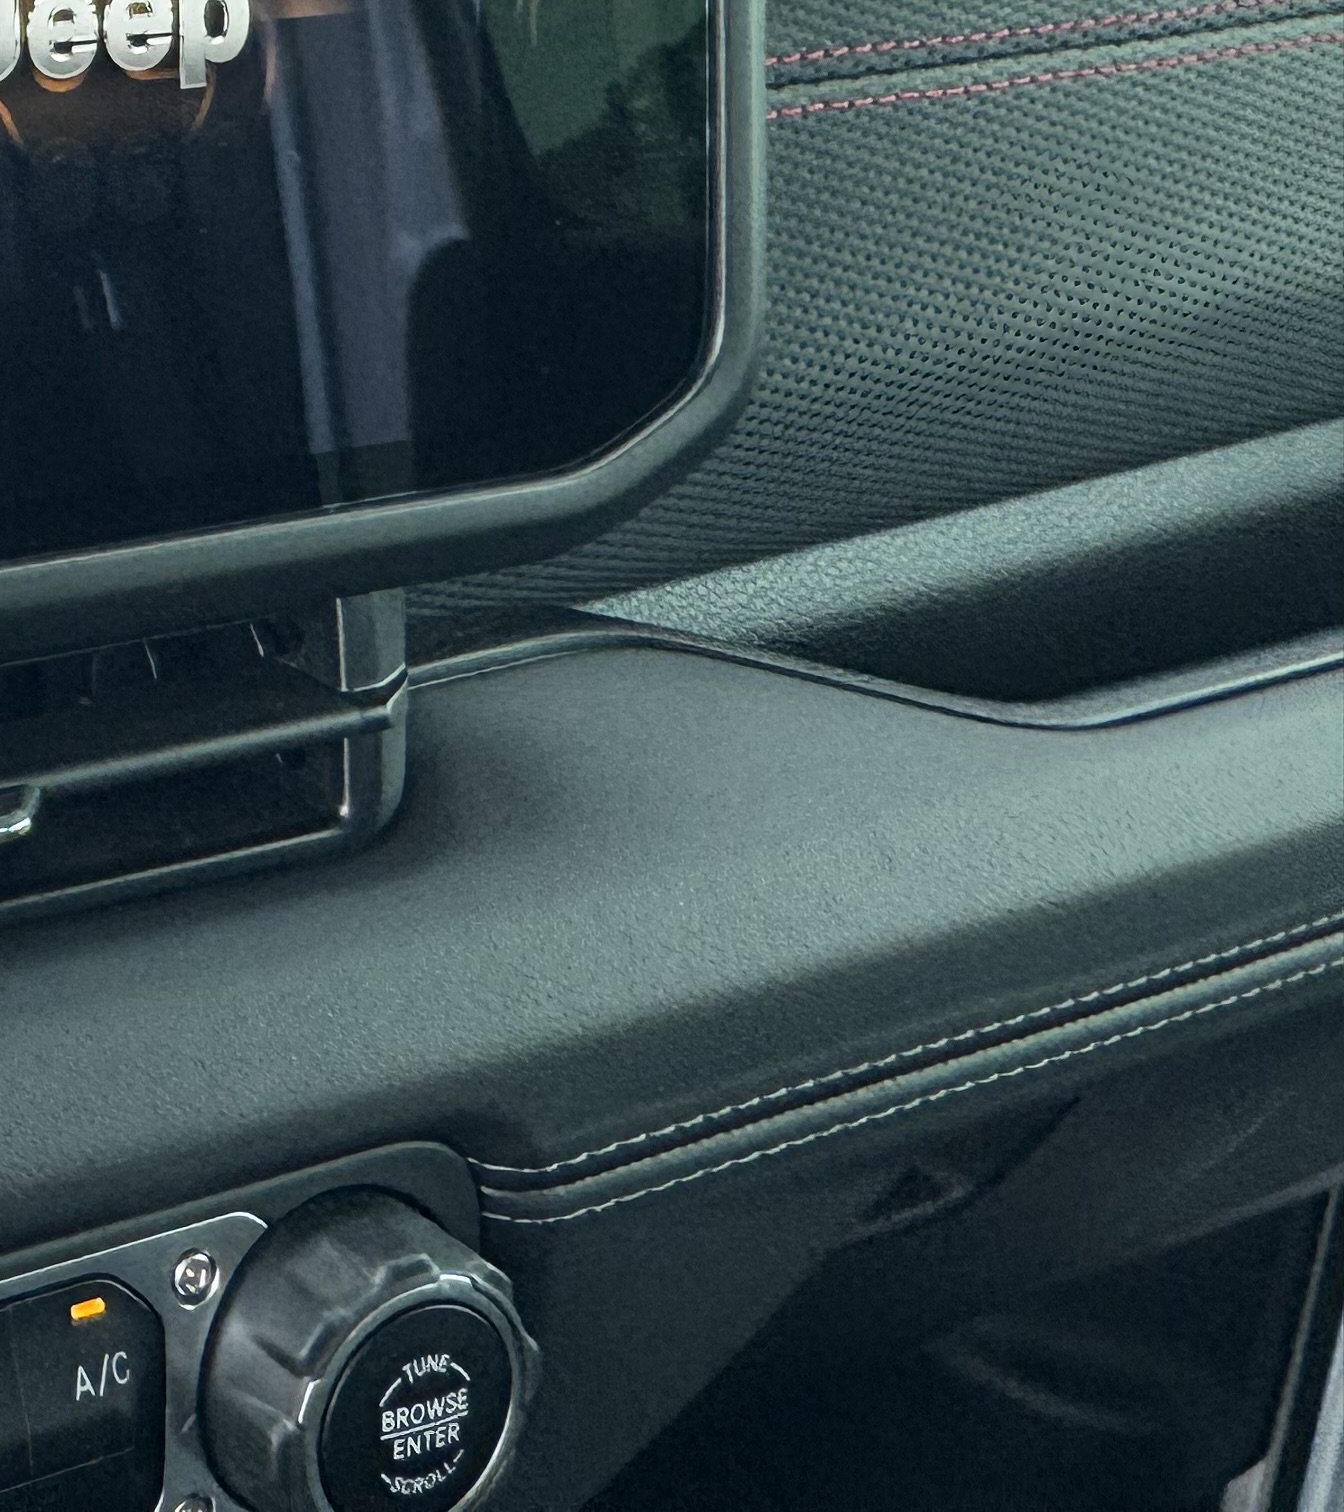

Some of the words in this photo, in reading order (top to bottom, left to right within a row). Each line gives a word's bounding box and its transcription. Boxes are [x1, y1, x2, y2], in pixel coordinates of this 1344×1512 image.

[75, 1350, 131, 1402] A/C
[401, 1353, 451, 1384] TUNE
[381, 1387, 469, 1433] BROWSE
[392, 1422, 460, 1460] ENTER
[388, 1461, 457, 1496] SCROLL
